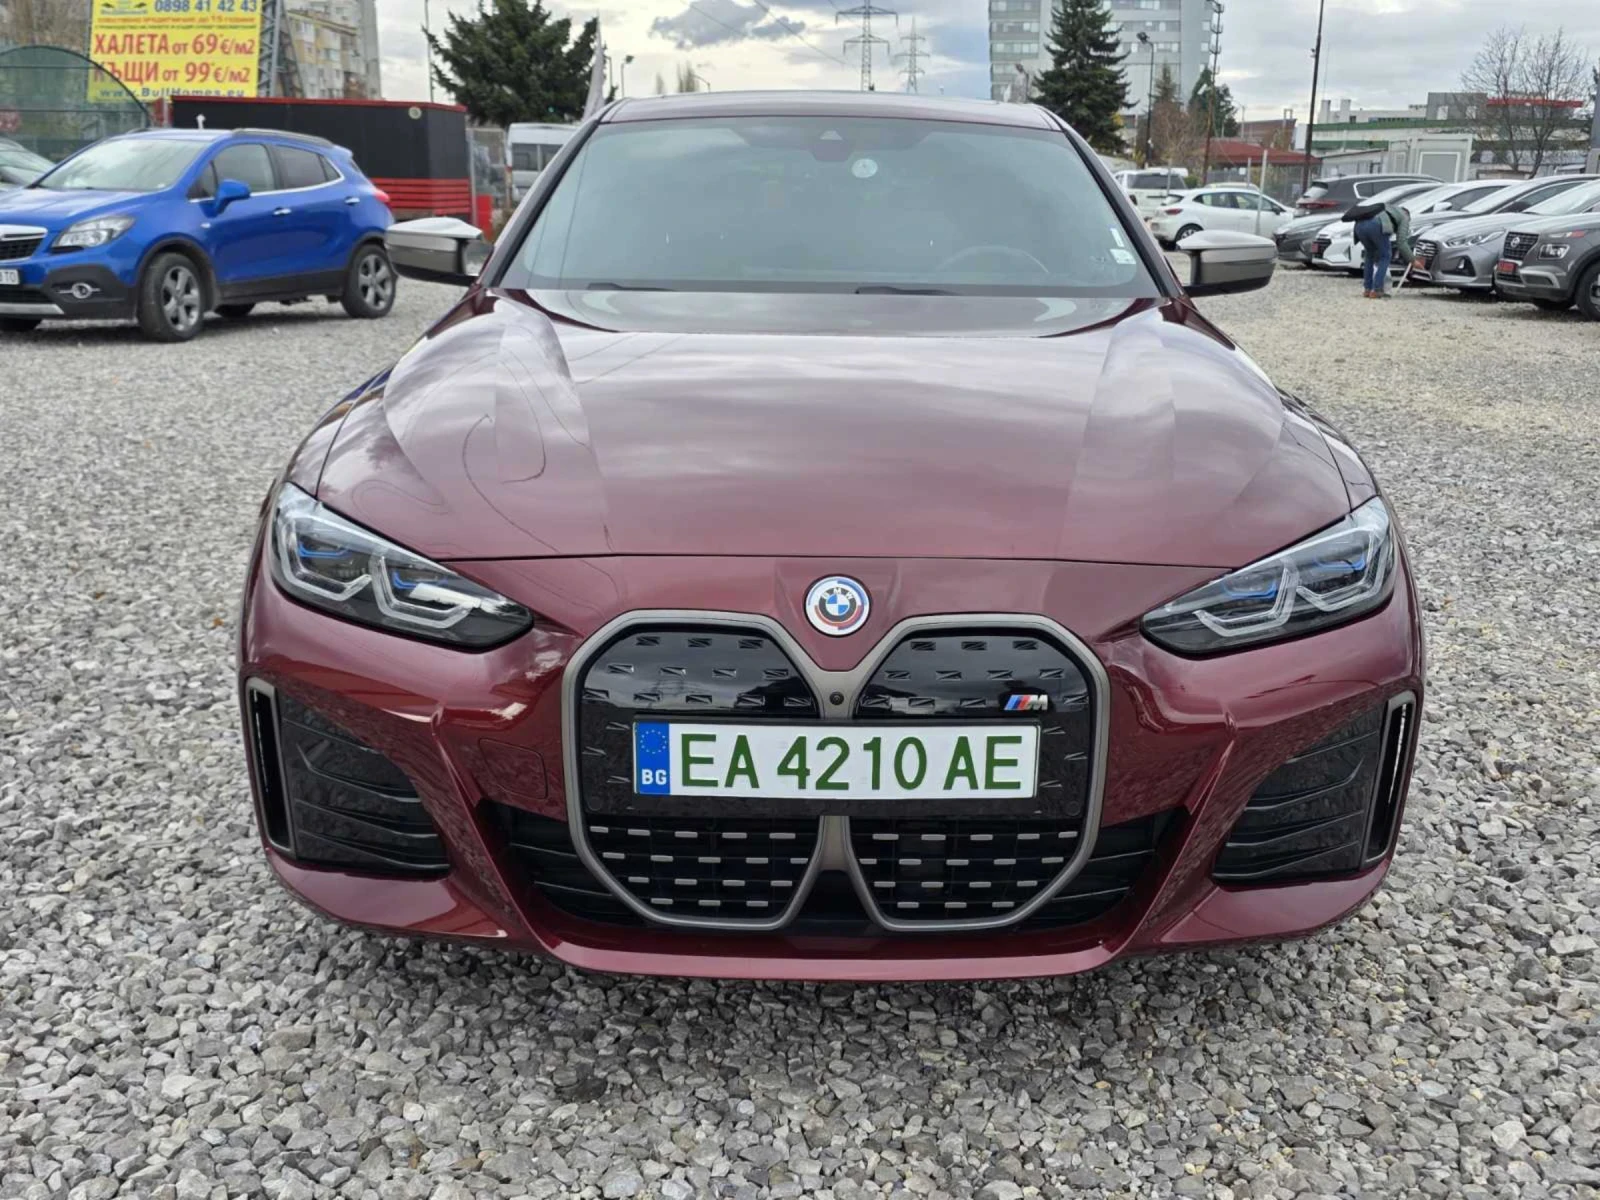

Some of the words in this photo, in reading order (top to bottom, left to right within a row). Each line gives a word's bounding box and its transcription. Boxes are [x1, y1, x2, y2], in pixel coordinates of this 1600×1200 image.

[154, 0, 190, 12] 0898
[195, 0, 211, 12] 41
[217, 0, 235, 12] 42
[240, 0, 257, 12] 43
[94, 33, 169, 54] ХАЛЕТА
[172, 42, 188, 54] от
[162, 69, 179, 82] от
[822, 586, 854, 600] BMW
[681, 733, 760, 789] EA
[777, 735, 927, 791] 4210
[943, 735, 1023, 791] AE
[641, 769, 667, 785] BG
